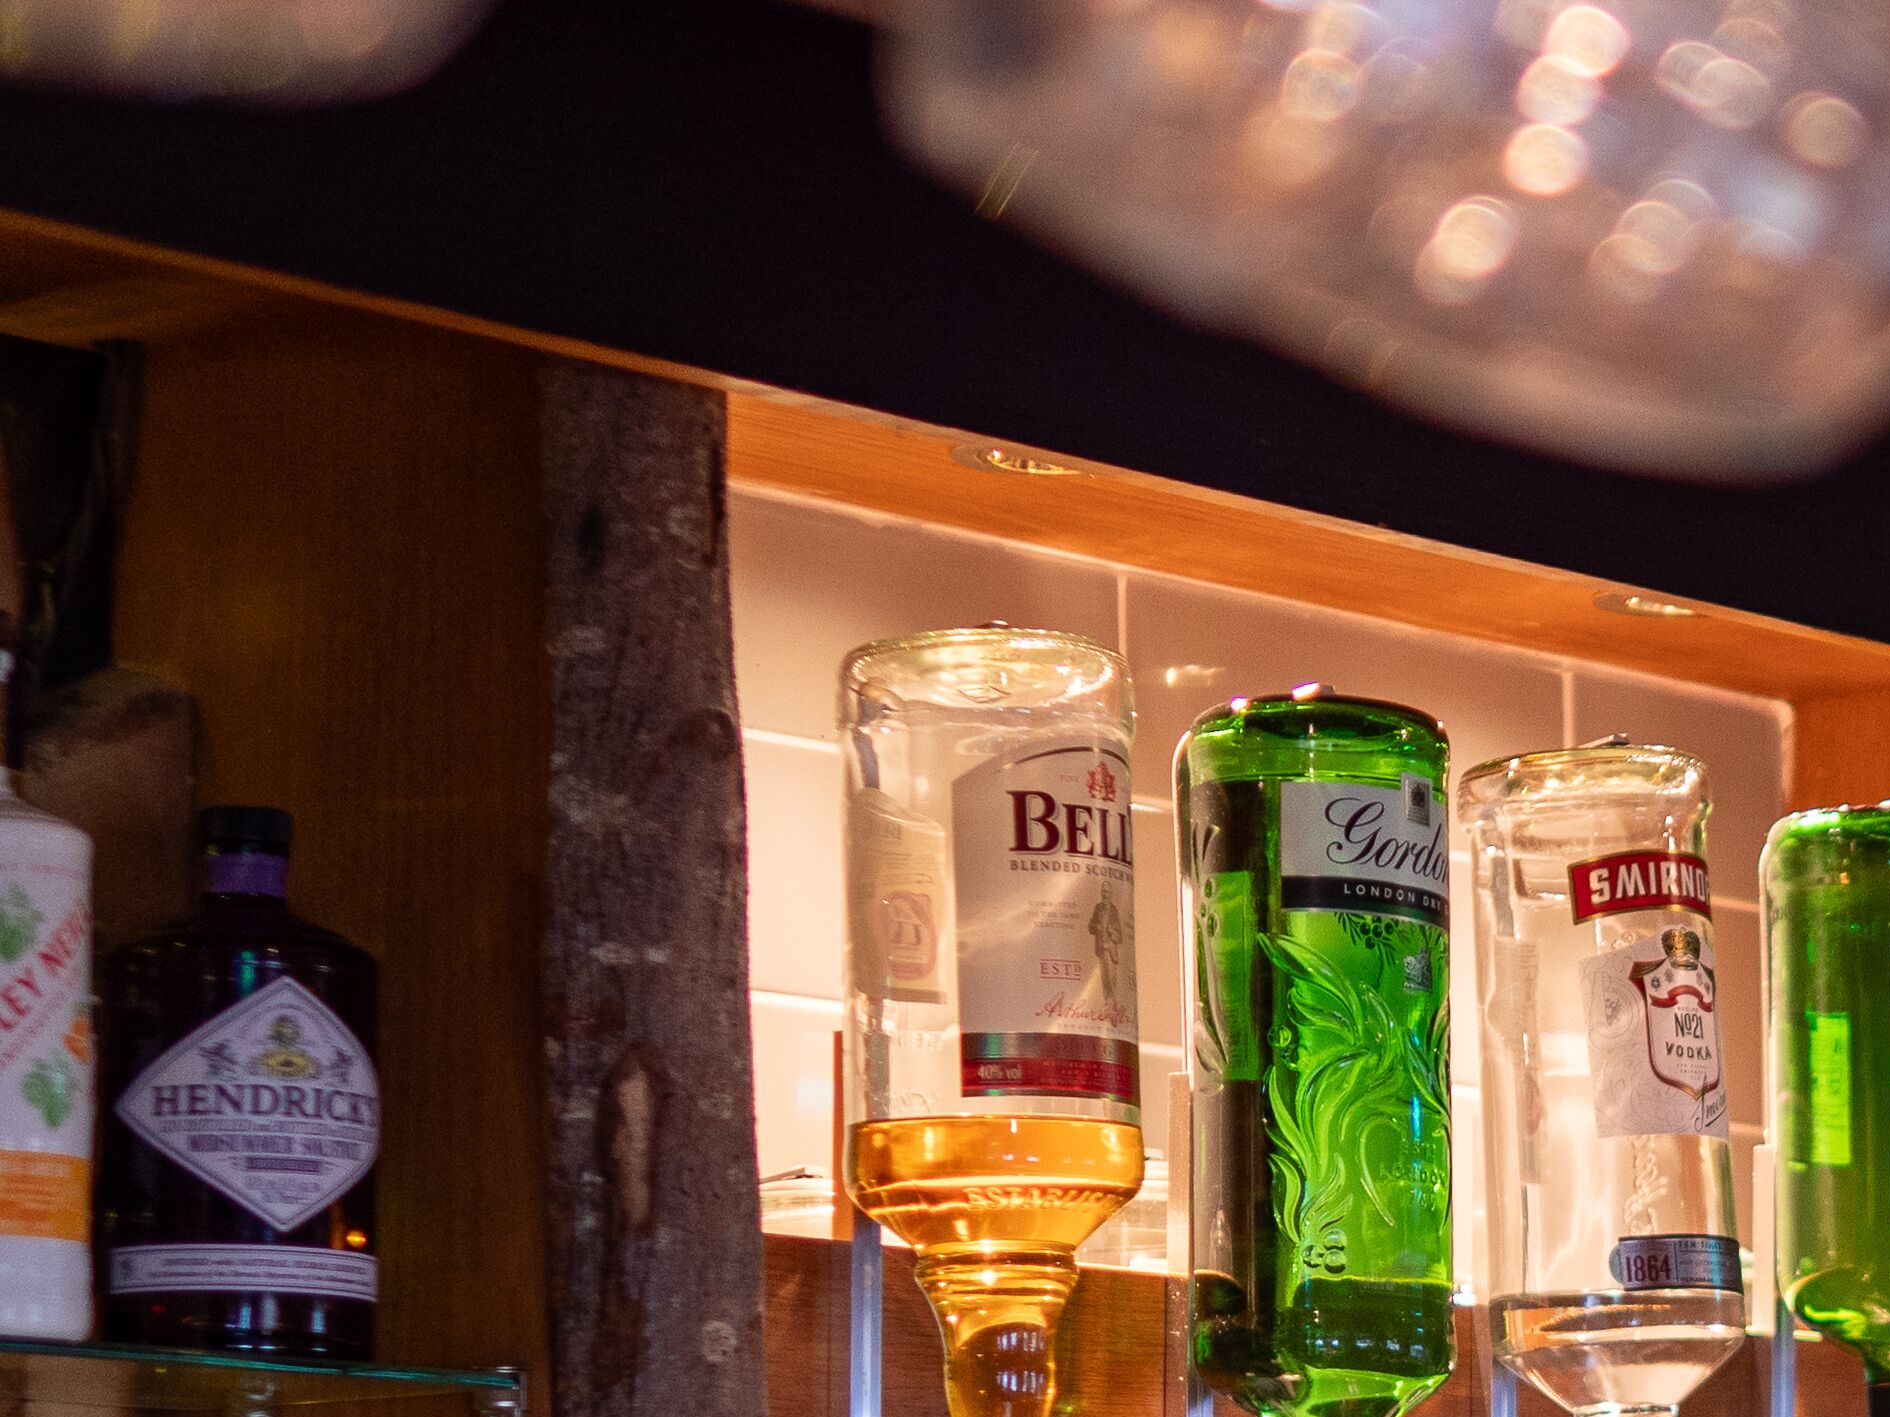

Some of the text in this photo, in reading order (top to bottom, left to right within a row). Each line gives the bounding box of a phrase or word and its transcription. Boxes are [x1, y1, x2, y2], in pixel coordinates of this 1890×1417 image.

[1324, 797, 1448, 884] Gordo
[1010, 859, 1081, 873] BLENDED
[1085, 864, 1125, 882] SCOTCH
[1344, 883, 1416, 903] LONDON
[1422, 896, 1442, 912] DRY
[1665, 1041, 1712, 1061] VODKA
[153, 1084, 377, 1124] HENDRICK
[1626, 1253, 1671, 1283] 1864
